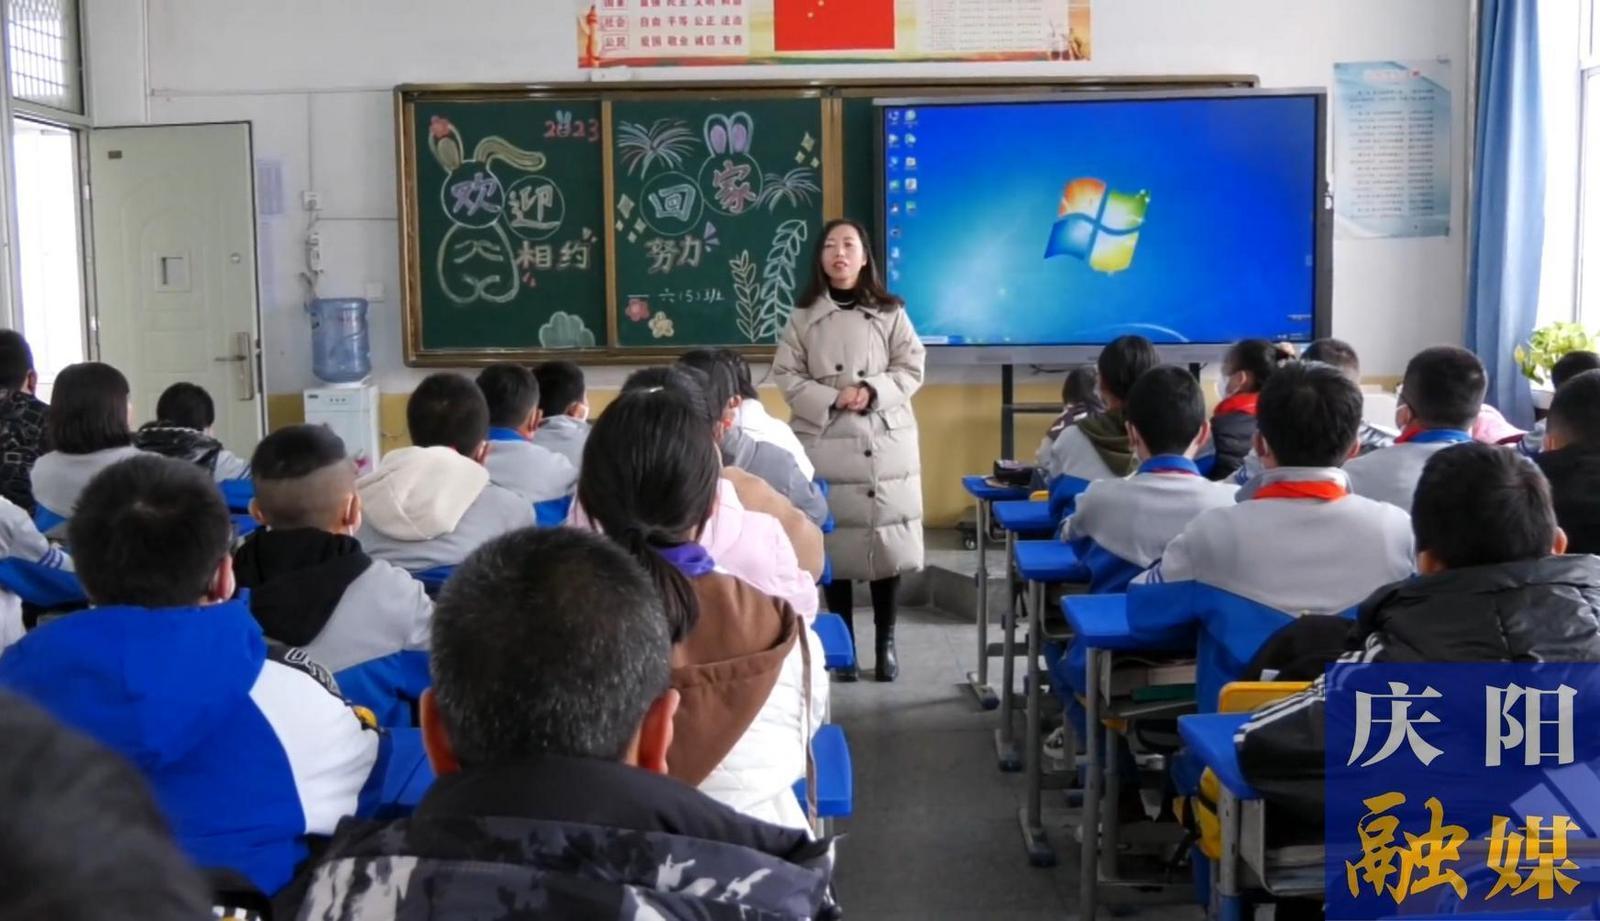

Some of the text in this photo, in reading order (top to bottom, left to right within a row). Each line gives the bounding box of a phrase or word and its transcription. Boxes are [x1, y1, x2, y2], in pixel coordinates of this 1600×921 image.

[640, 16, 661, 27] 自由
[668, 16, 688, 27] 平等
[694, 16, 716, 26] 公正
[543, 115, 600, 142] 2023
